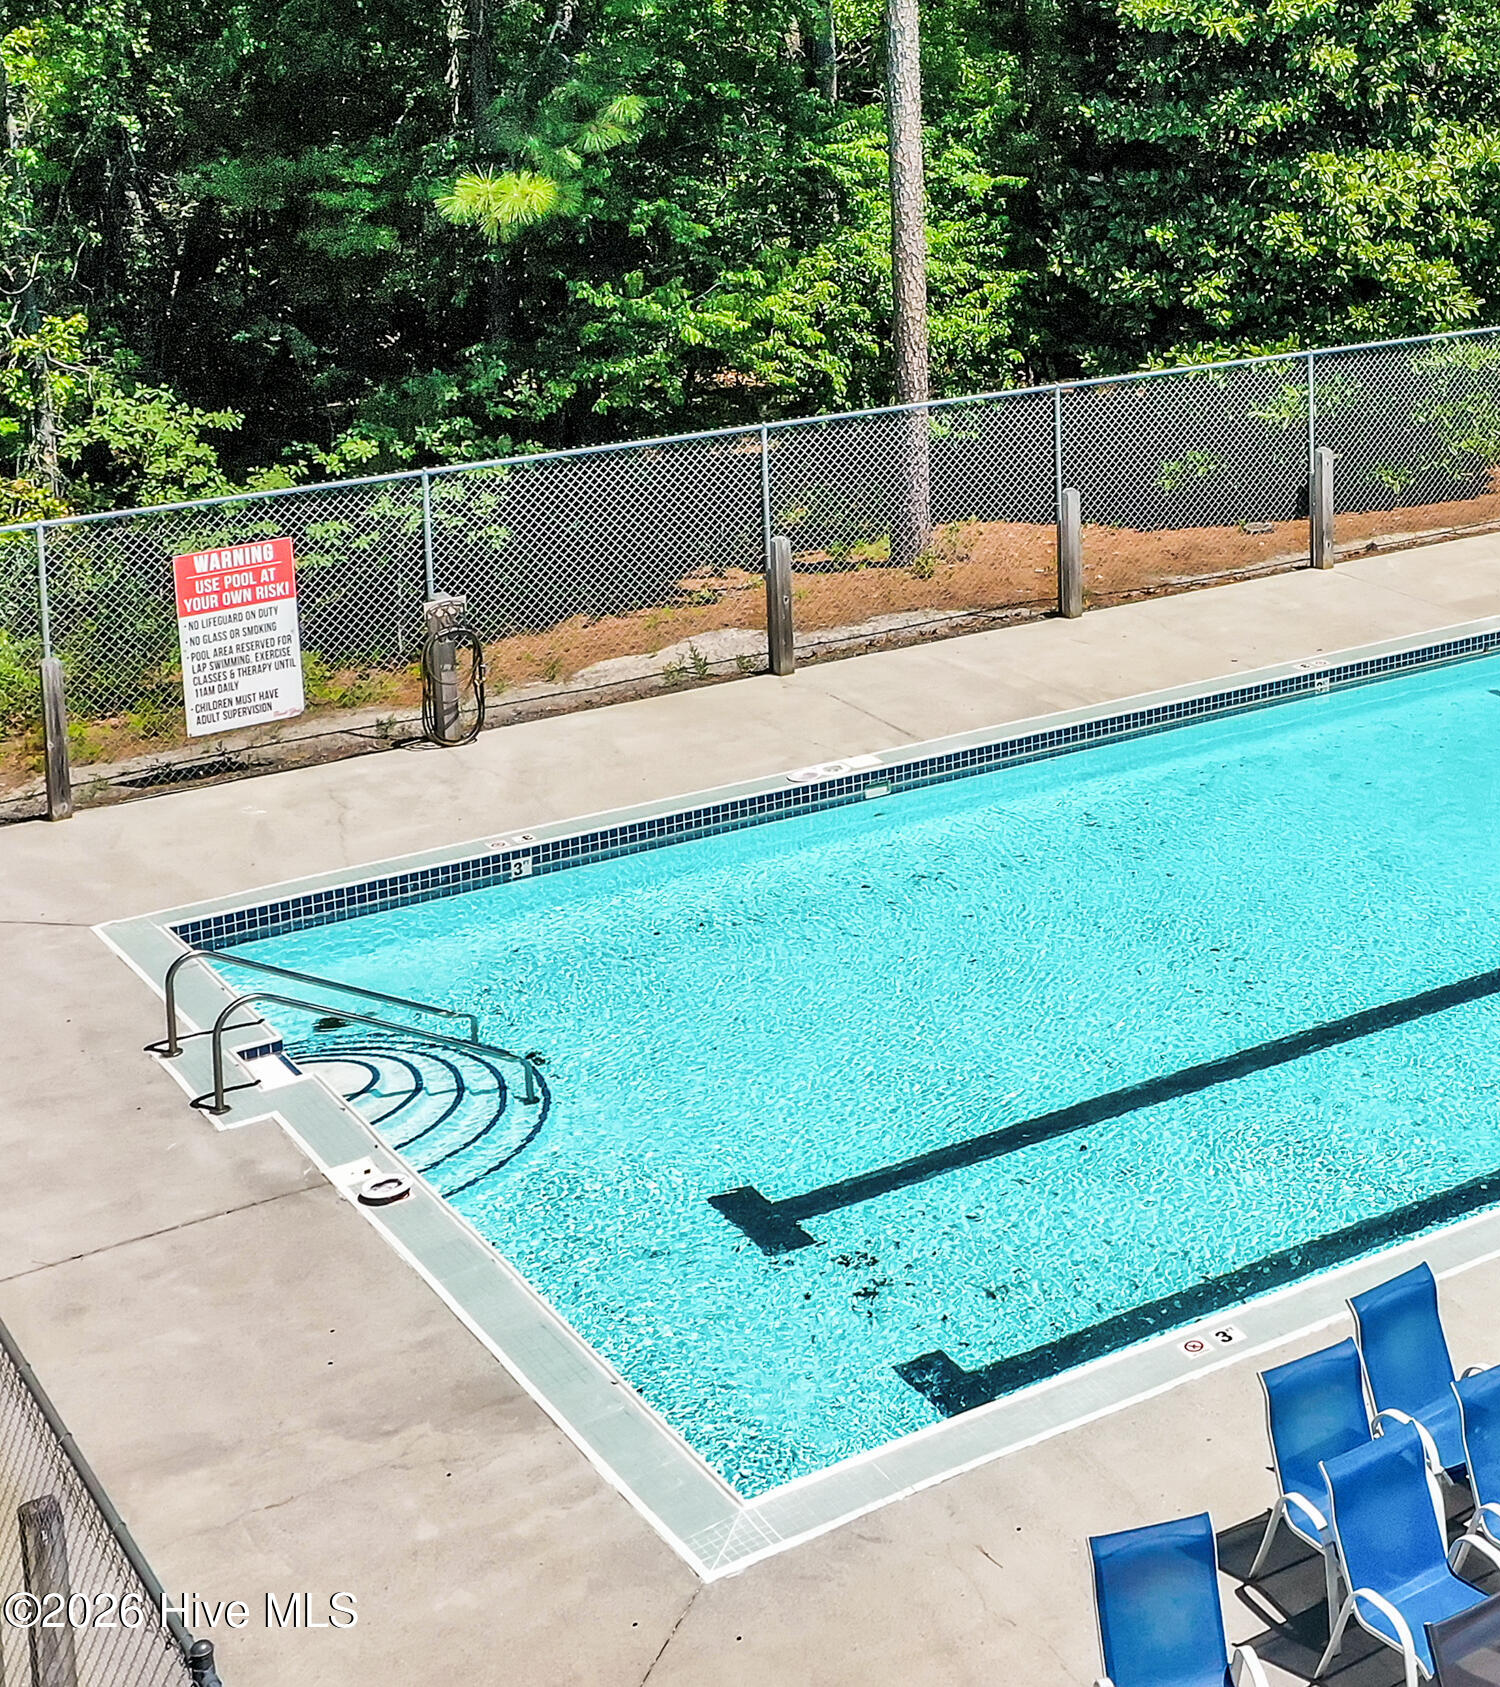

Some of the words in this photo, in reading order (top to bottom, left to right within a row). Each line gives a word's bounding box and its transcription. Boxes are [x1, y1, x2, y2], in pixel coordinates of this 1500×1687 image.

[193, 543, 274, 574] WARNING
[195, 577, 221, 594] USE
[224, 572, 257, 589] POOL
[260, 568, 276, 583] AT
[184, 595, 219, 613] YOUR
[222, 588, 252, 606] OWN
[188, 620, 199, 631] NO
[201, 612, 243, 629] LIFEGUARD
[245, 610, 256, 621] ON
[258, 606, 279, 619] DUTY
[189, 636, 201, 647] NO
[202, 630, 227, 645] GLASS
[229, 628, 240, 639] OR
[242, 621, 277, 637] SMOKING
[191, 649, 210, 662] POOL
[213, 645, 234, 658] AREA
[235, 637, 275, 654] RESERVED
[277, 634, 292, 646] FOR
[192, 662, 207, 675] LAP
[255, 646, 291, 662] EXERCISE
[193, 670, 227, 687] CLASSES
[229, 669, 235, 679] &
[237, 661, 272, 678] THERAPY
[274, 658, 296, 671] UNTIL
[195, 685, 215, 698] 11AM
[217, 680, 239, 694] DAILY
[195, 697, 233, 714] CHILDREN
[235, 692, 256, 705] MUST
[259, 688, 279, 700] HAVE
[196, 712, 220, 726] ADULT
[223, 702, 273, 721] SUPERVISION
[514, 862, 523, 876] 3
[1215, 1331, 1233, 1343] 3
